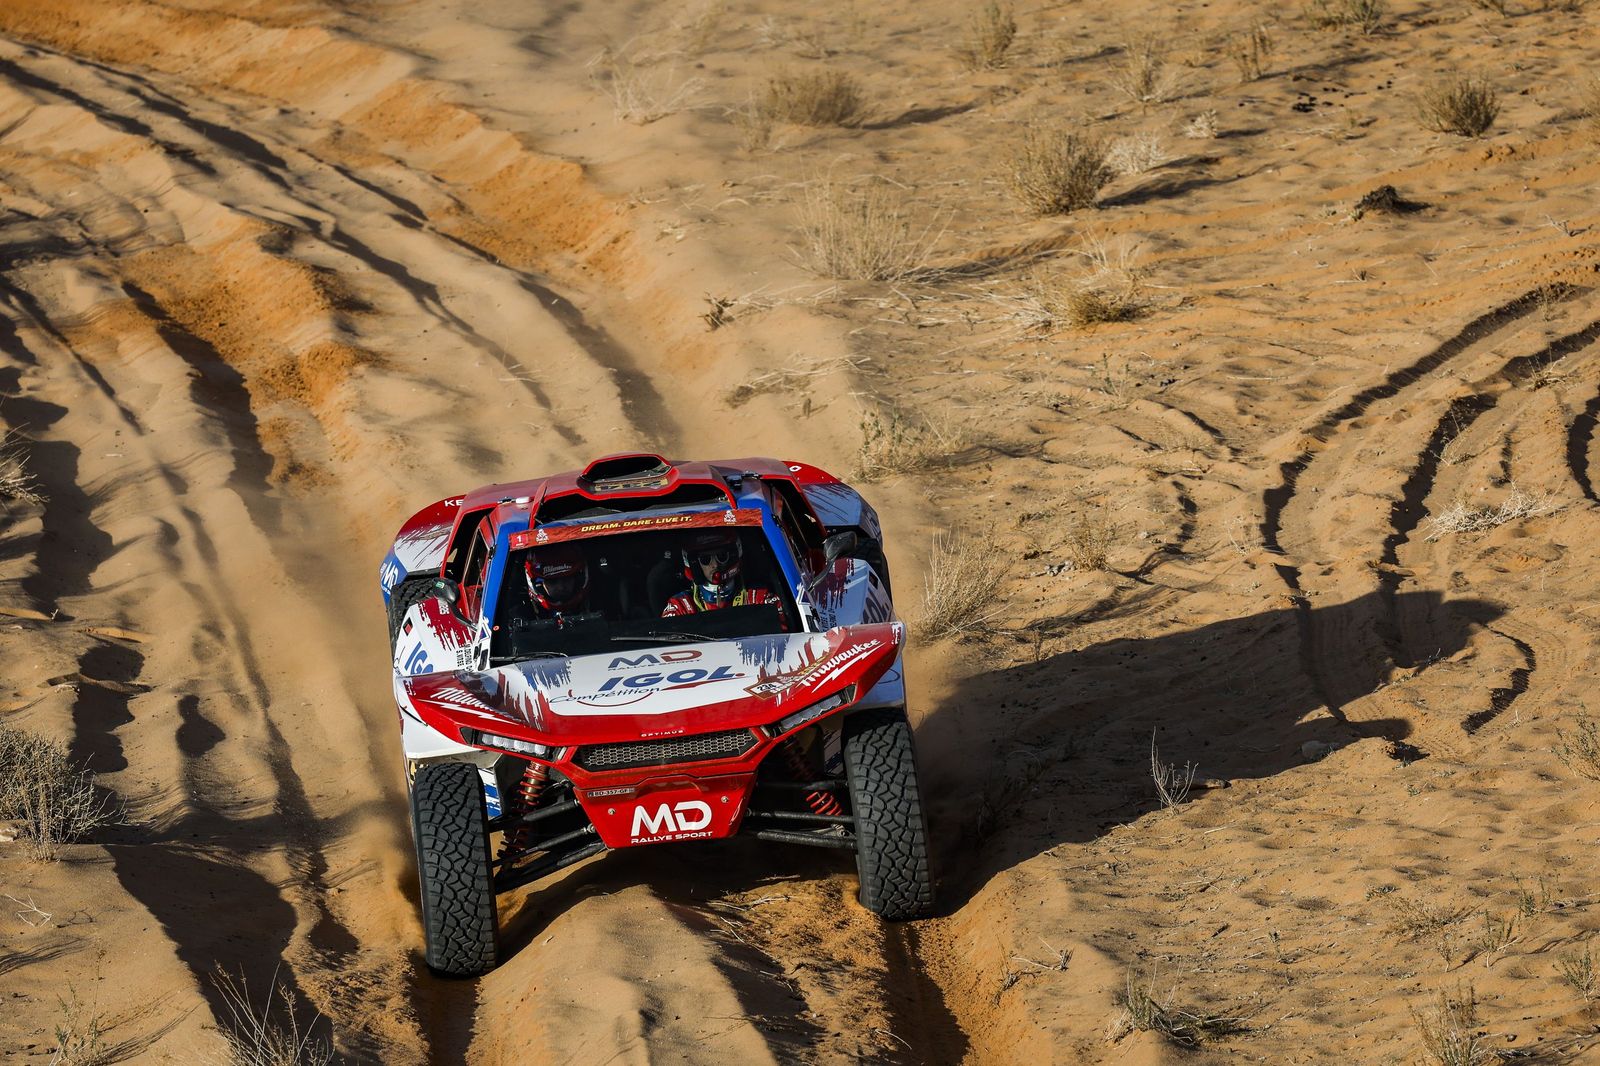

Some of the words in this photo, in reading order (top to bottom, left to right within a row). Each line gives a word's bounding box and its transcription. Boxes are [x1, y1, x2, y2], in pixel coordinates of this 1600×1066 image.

[581, 522, 621, 533] DREAM.
[623, 519, 652, 528] DARE.
[655, 516, 684, 524] LIVE
[598, 665, 737, 692] IGOL
[550, 687, 660, 704] Compétition
[631, 800, 712, 837] MD
[631, 834, 673, 844] RALLYE
[675, 831, 713, 840] SPORT
